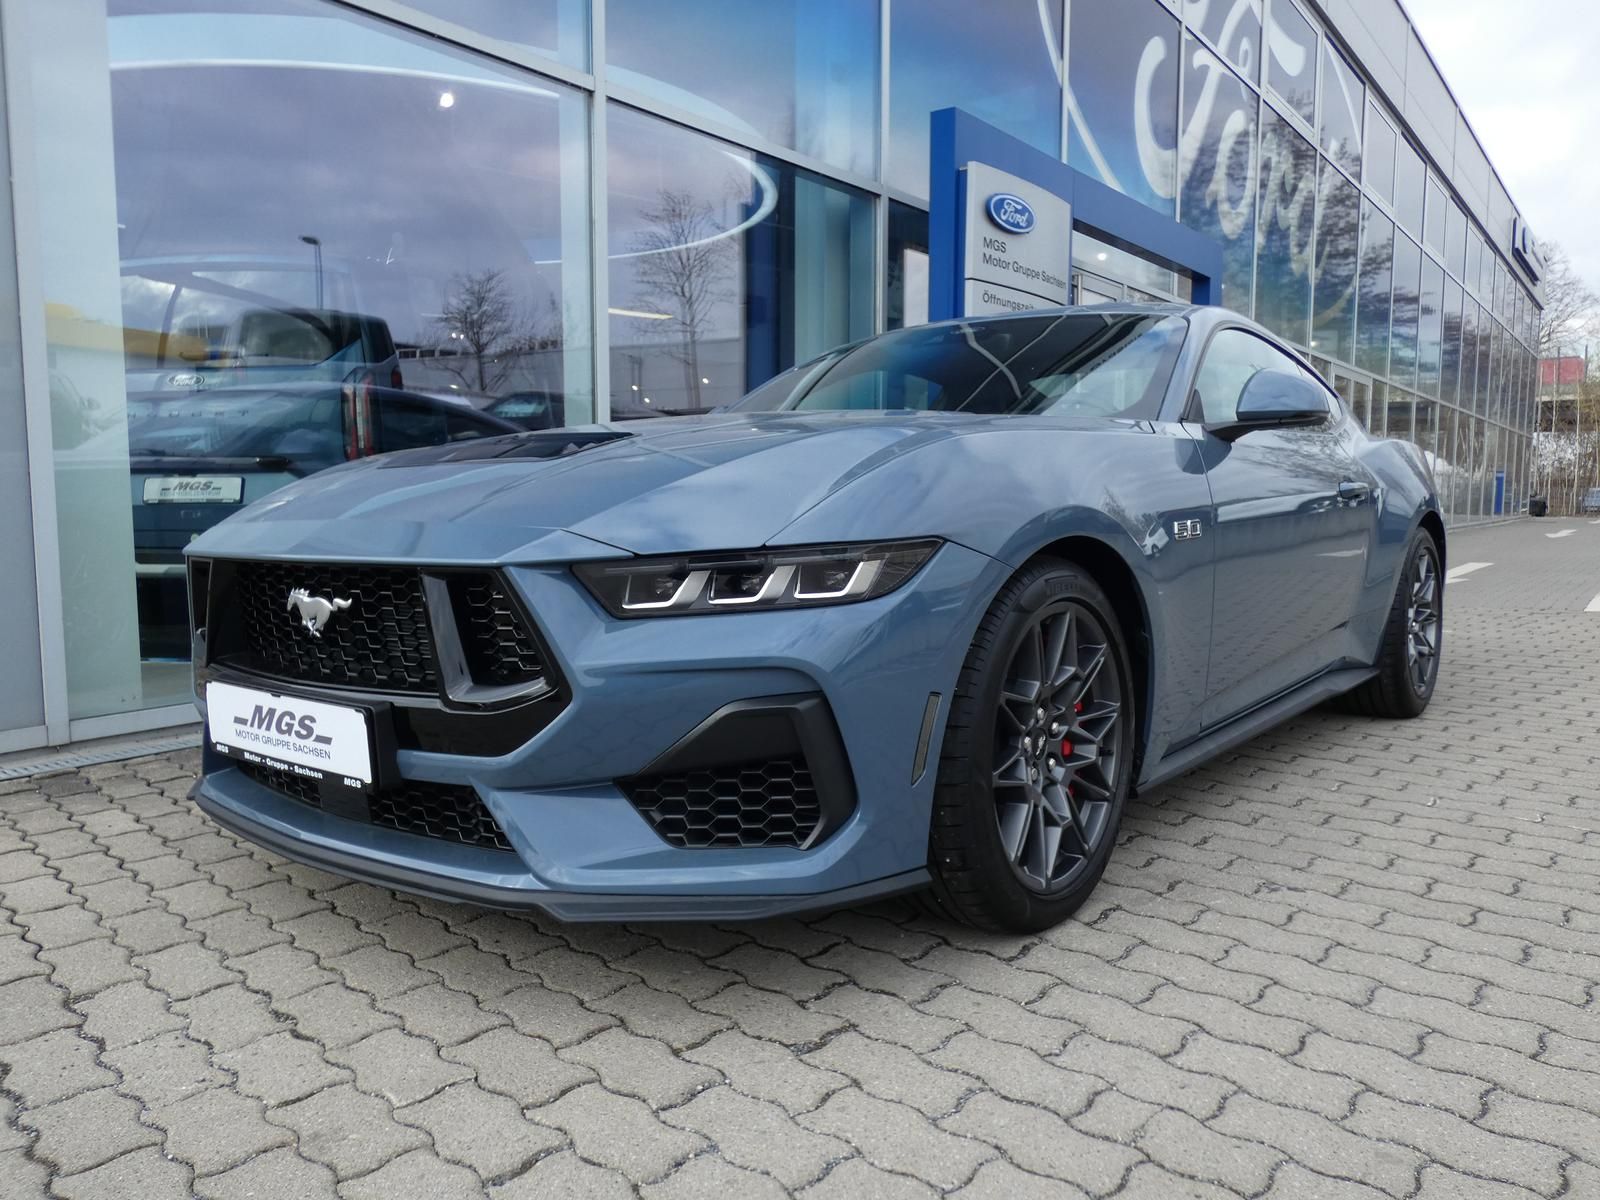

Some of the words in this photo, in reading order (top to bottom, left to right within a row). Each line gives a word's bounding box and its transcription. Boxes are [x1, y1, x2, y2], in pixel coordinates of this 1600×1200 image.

[1000, 199, 1029, 227] Ford
[983, 236, 1006, 253] MGS
[983, 252, 1010, 270] Motor
[1012, 260, 1040, 280] Gruppe
[1041, 270, 1066, 289] Sachsen
[174, 375, 196, 386] Ford
[173, 481, 213, 491] MGS
[249, 704, 317, 740] MGS
[235, 729, 260, 742] MOTOR
[261, 735, 291, 751] GRUPPE
[292, 741, 331, 760] SACHSEN
[244, 751, 262, 764] Motor
[266, 757, 289, 771] Gruppe
[294, 765, 323, 780] Sachsen
[343, 777, 362, 789] MGS
